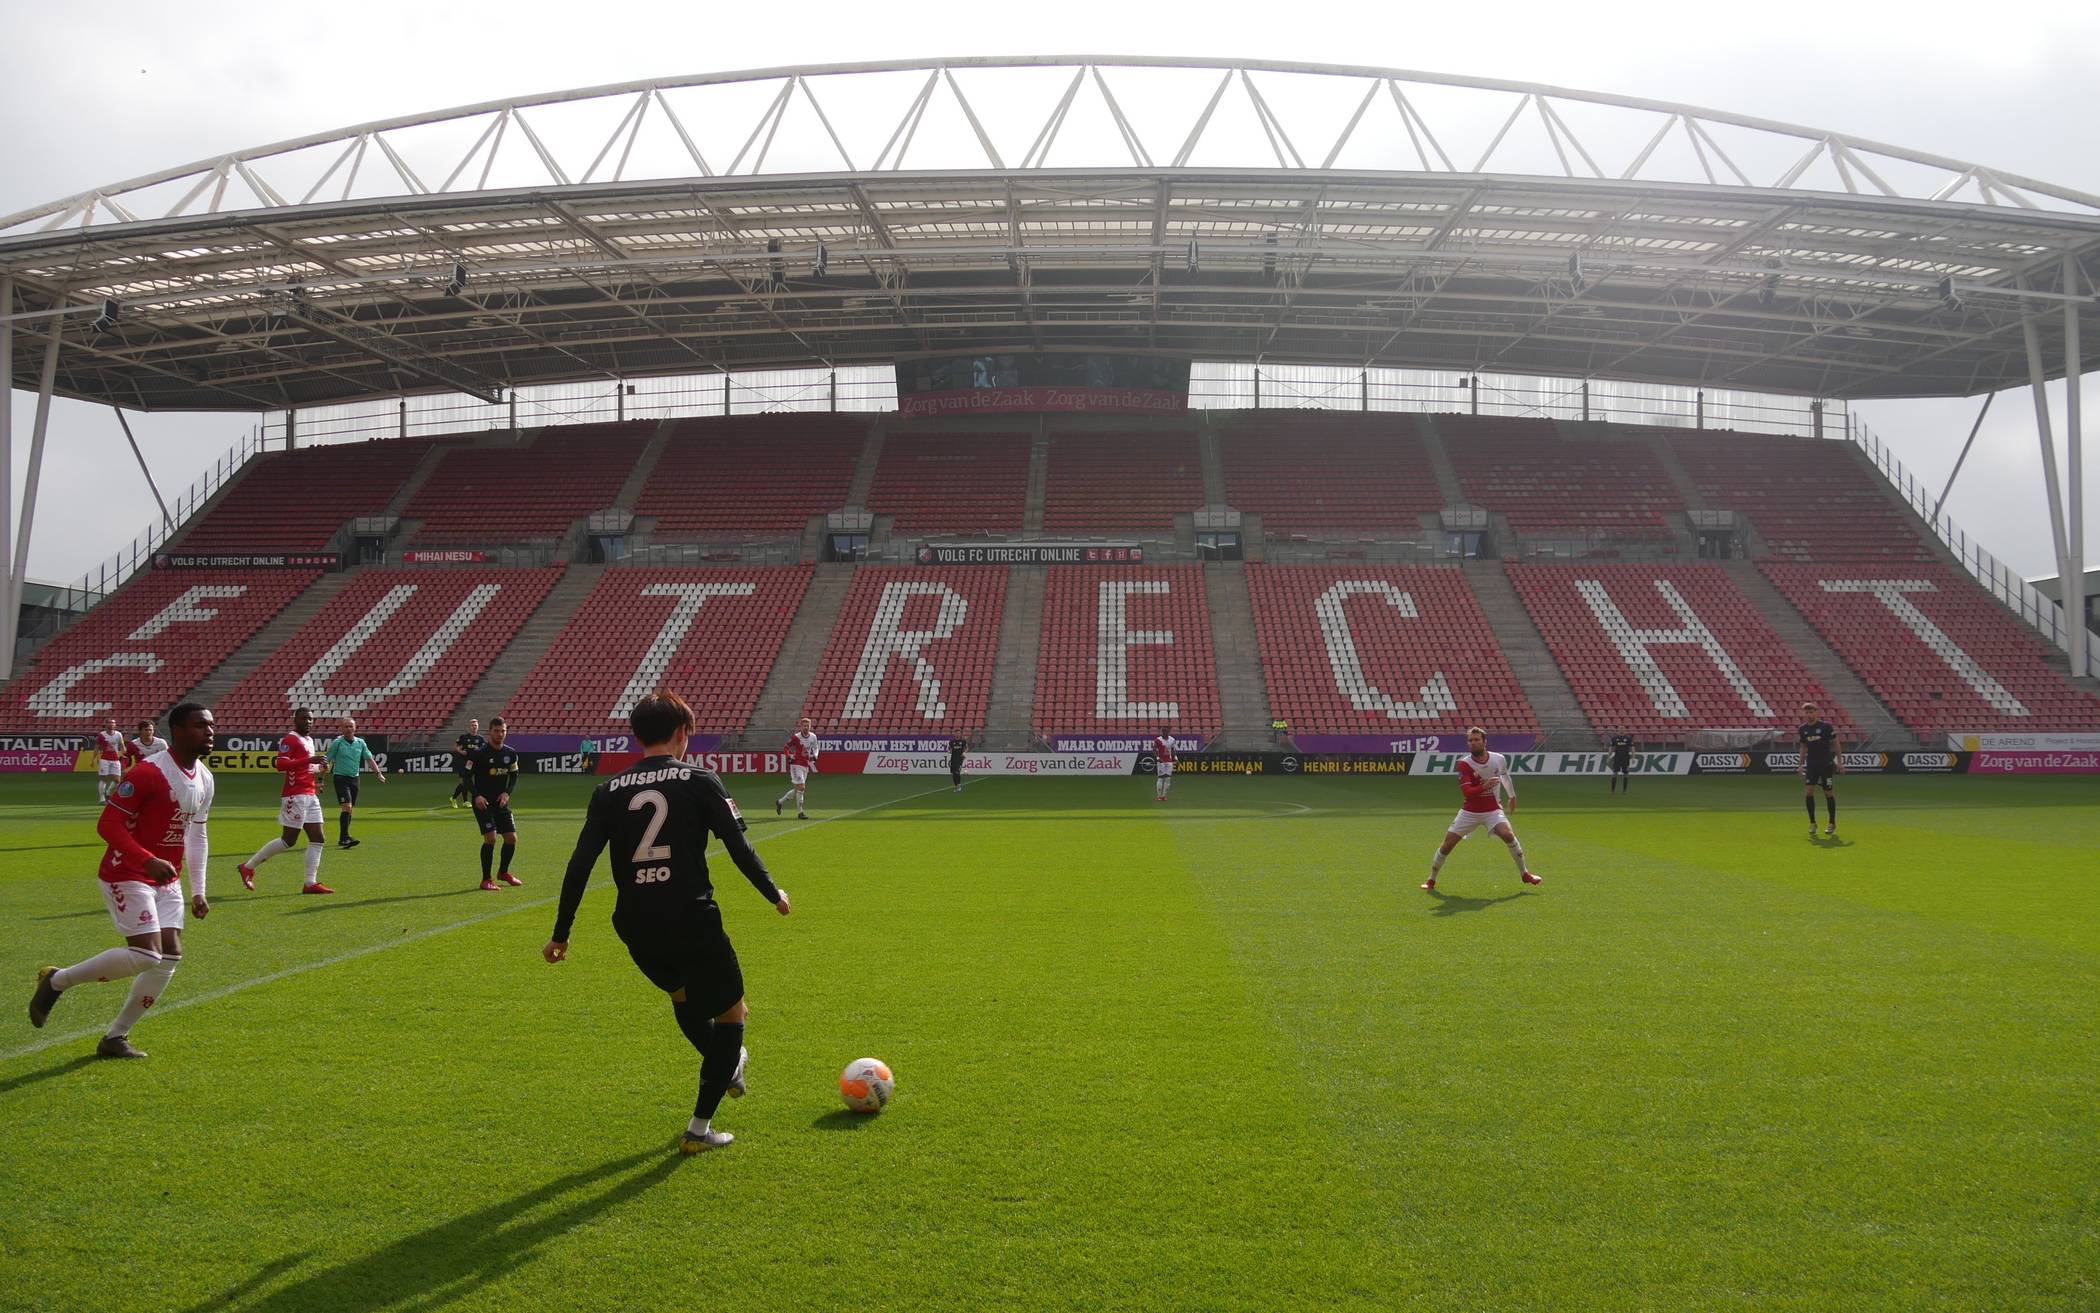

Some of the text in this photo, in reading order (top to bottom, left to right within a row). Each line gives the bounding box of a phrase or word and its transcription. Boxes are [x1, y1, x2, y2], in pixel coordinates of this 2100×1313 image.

[903, 389, 1034, 413] Zorg van de Zaak
[1046, 390, 1181, 411] Zorg van de Zaak
[171, 556, 284, 566] VOLG FC UTRECHT ONLINE
[415, 551, 472, 562] MIHAI NESU
[938, 549, 1080, 562] VOLG FC UTRECHT ONLINE
[0, 738, 83, 750] TALENT
[227, 737, 272, 752] Only
[591, 736, 629, 753] ELE2
[844, 740, 887, 751] OMDAT
[890, 740, 916, 751] HET
[1058, 740, 1095, 751] MAAR
[1096, 740, 1141, 751] OMDAT
[1390, 736, 1440, 753] TELE2
[1982, 738, 2035, 746] DE AREND
[22, 753, 38, 766] de
[39, 753, 72, 766] Zaak
[405, 753, 453, 773] TELE2
[536, 753, 583, 773] TELE2
[686, 753, 758, 772] MSTEL
[876, 755, 909, 771] Zorg
[911, 758, 938, 769] van
[1006, 757, 1122, 773] Zorg van de Zaak
[1172, 761, 1263, 772] ENRI & HERMAN
[1304, 761, 1405, 772] HENRI & HERMAN
[1701, 755, 1738, 766] DASSY
[1770, 755, 1801, 766] DASS
[1908, 755, 1945, 766] DASSY
[1980, 754, 2099, 771] Zorg van de Zaak
[609, 767, 691, 792] DUISBURG
[628, 789, 671, 863] 2
[634, 866, 671, 884] SEO
